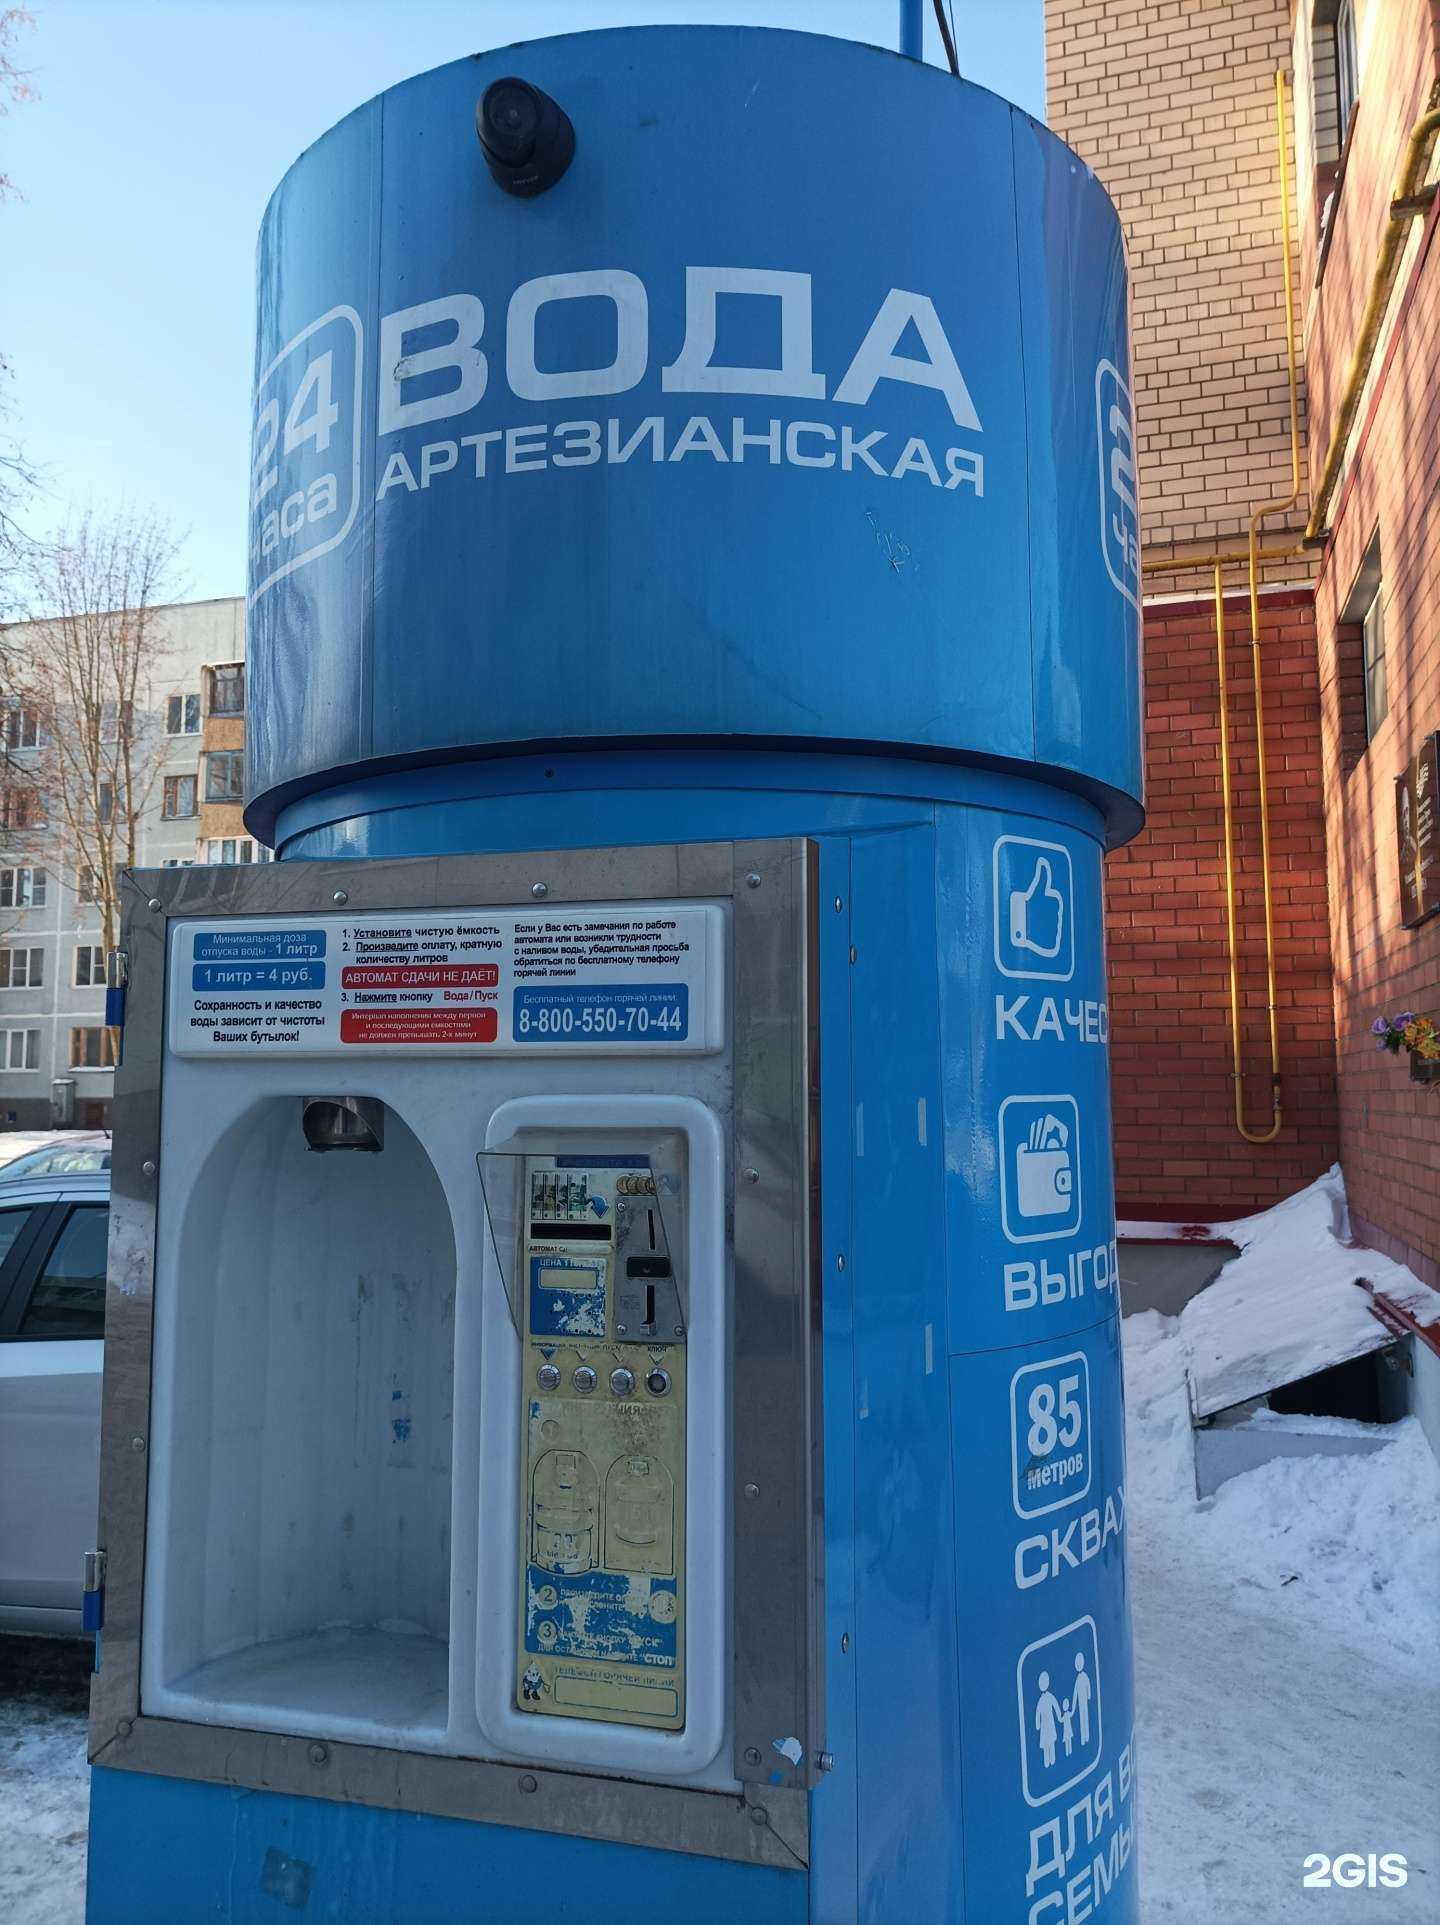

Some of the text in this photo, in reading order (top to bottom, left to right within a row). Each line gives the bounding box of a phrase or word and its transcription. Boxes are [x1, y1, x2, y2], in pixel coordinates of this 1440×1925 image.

[378, 266, 983, 436] ВОДА
[375, 416, 984, 501] АРТЕЗИАНСКАЯ
[342, 925, 500, 939] 1. Установите чистую ёмкость
[514, 920, 676, 933] Если у Вас есть замечания по работе
[213, 933, 307, 944] Минимальная доза
[342, 939, 503, 952] 2. Произведите оплату, кратную
[514, 933, 662, 944] автомата или возникли трудности
[201, 946, 239, 958] отпуска
[241, 946, 266, 957] воды
[275, 943, 282, 955] 1
[286, 943, 319, 957] литр
[521, 946, 559, 955] наливом
[588, 944, 651, 955] убедительная
[652, 942, 690, 952] просьба
[355, 953, 449, 965] количеству литров
[513, 954, 680, 967] обратиться по бесплатному телефону
[204, 969, 212, 983] 1
[215, 971, 252, 985] литр
[268, 967, 278, 981] 4
[281, 966, 313, 984] руб.
[345, 968, 496, 984] АВТОМАТ СДАЧИ НЕ ДАЁТ!
[513, 967, 576, 979] горячей линии
[340, 992, 350, 1002] 3.
[354, 992, 398, 1003] Нажмите
[400, 992, 433, 1003] кнопку
[523, 994, 574, 1004] Бесплатный
[194, 999, 322, 1013] Сохранность и качество
[190, 1015, 325, 1028] воды зависит от чистоты
[519, 1006, 682, 1033] 8-800-550-70-44
[213, 1030, 300, 1044] Ваших бутылок!
[1027, 1374, 1082, 1457] 85
[1027, 1453, 1084, 1490] метров
[1025, 1770, 1114, 1897] ДЛЯ
